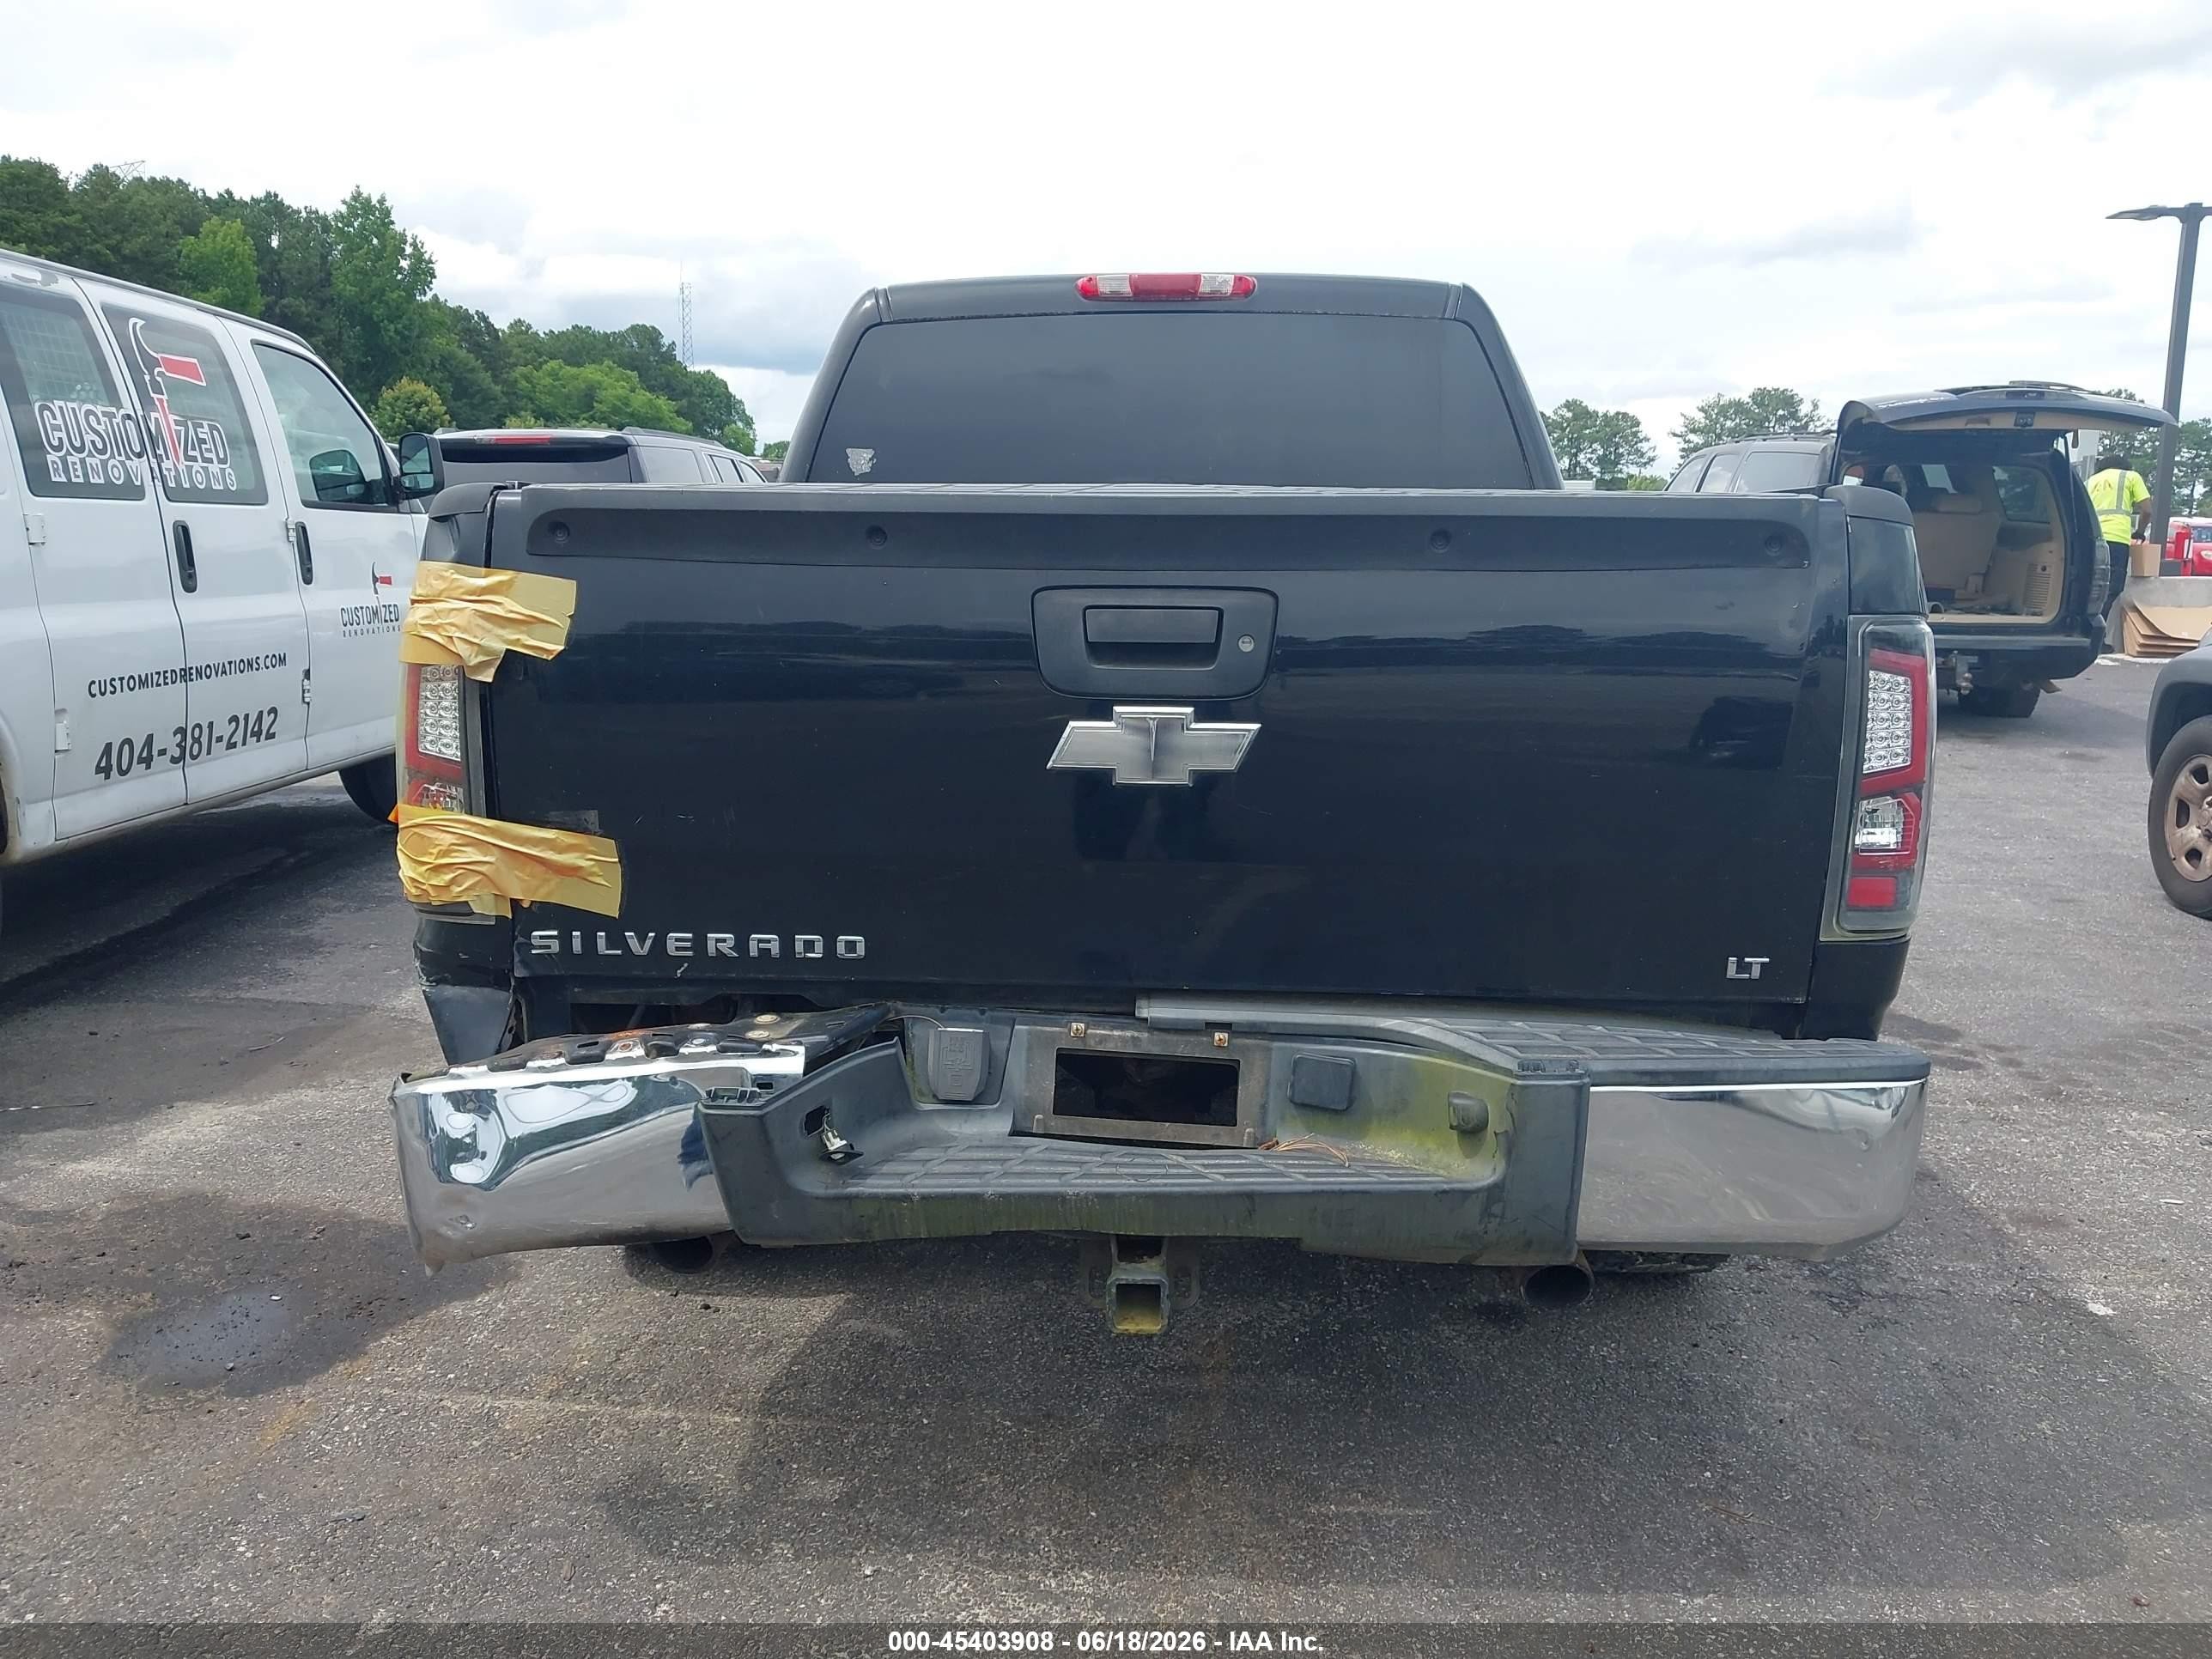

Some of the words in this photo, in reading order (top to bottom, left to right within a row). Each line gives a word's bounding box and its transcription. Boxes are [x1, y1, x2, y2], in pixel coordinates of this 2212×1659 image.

[33, 400, 230, 468] CUSTOMIZED
[46, 454, 237, 491] RENOVATIONS
[340, 604, 400, 627] CUSTOMIZED
[343, 624, 401, 637] RENOVATIONS
[88, 653, 287, 698] CUSTOMIZEDRENOVATIONS.COM
[94, 707, 278, 781] 404-381-2142
[530, 930, 866, 959] SILVERADO
[1726, 957, 1770, 980] LT
